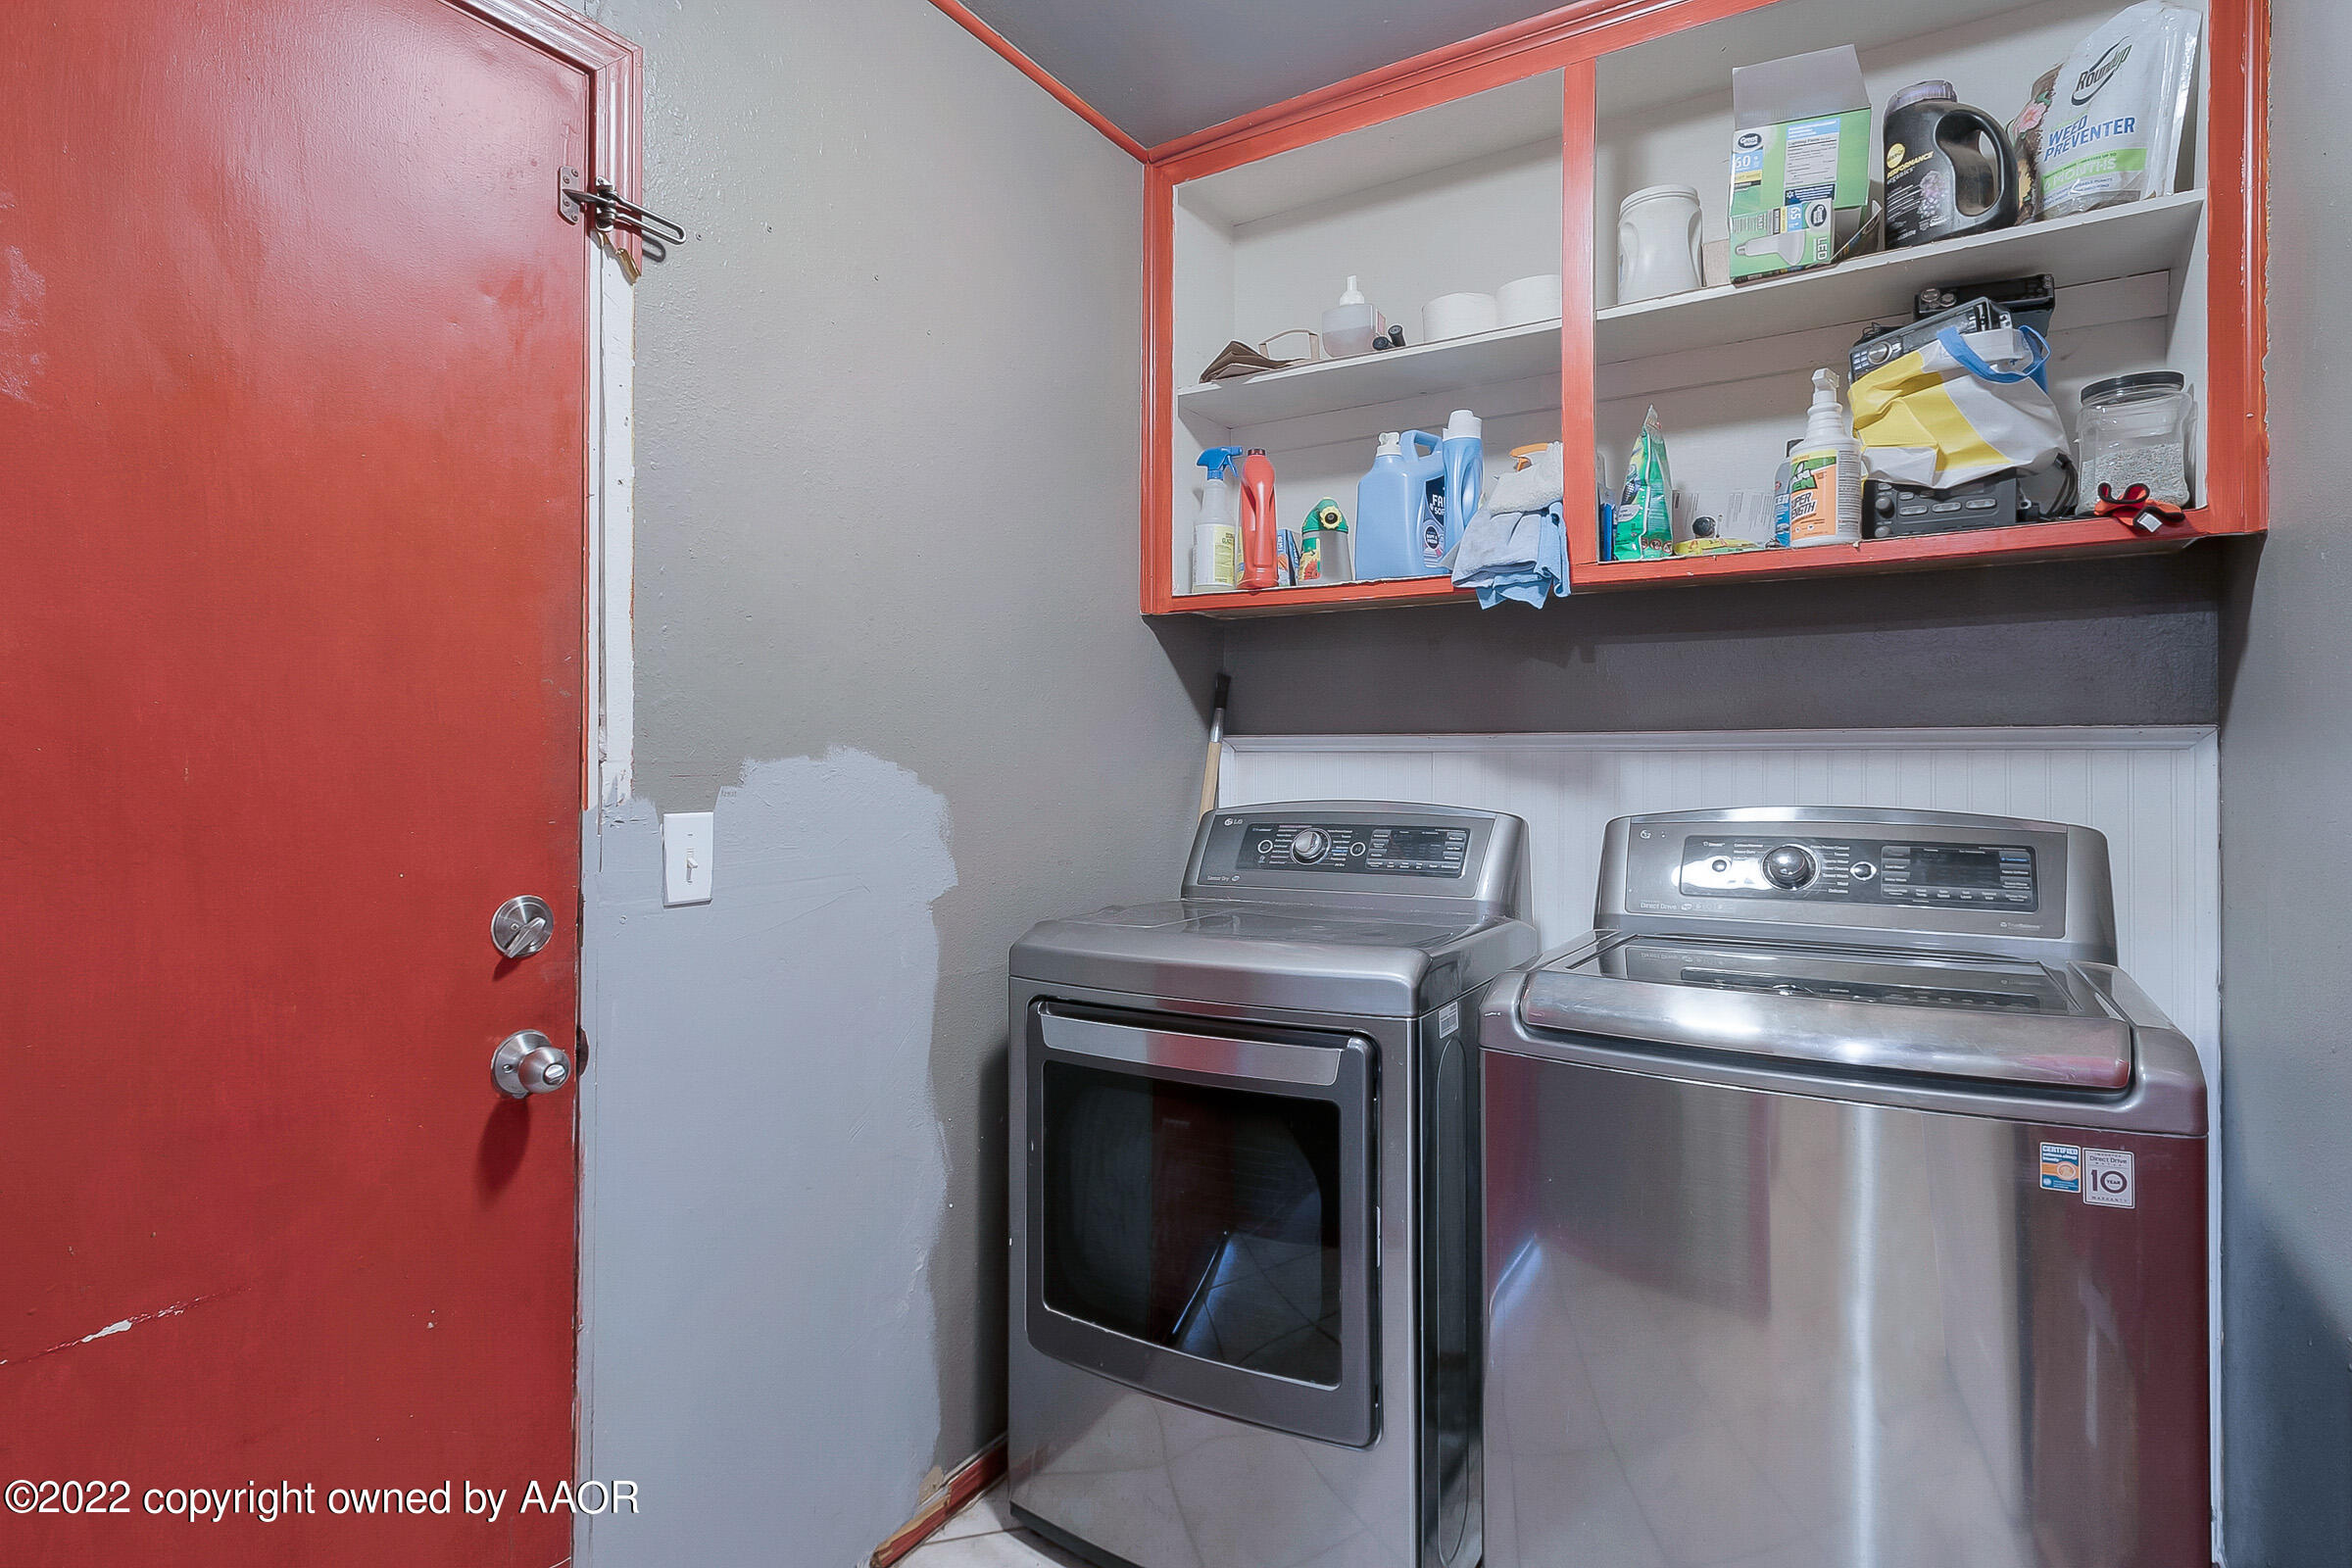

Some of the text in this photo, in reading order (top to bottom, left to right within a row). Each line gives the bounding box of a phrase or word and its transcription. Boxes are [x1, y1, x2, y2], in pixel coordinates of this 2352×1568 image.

[2076, 44, 2132, 92] Roundup
[2044, 117, 2135, 162] PREVENTER
[2048, 114, 2088, 146] WEED
[1886, 151, 1935, 179] PERFORMANCE
[2052, 158, 2117, 186] MONTHS
[1818, 237, 1828, 261] LED
[1433, 494, 1446, 508] FA
[2090, 1169, 2128, 1194] 10
